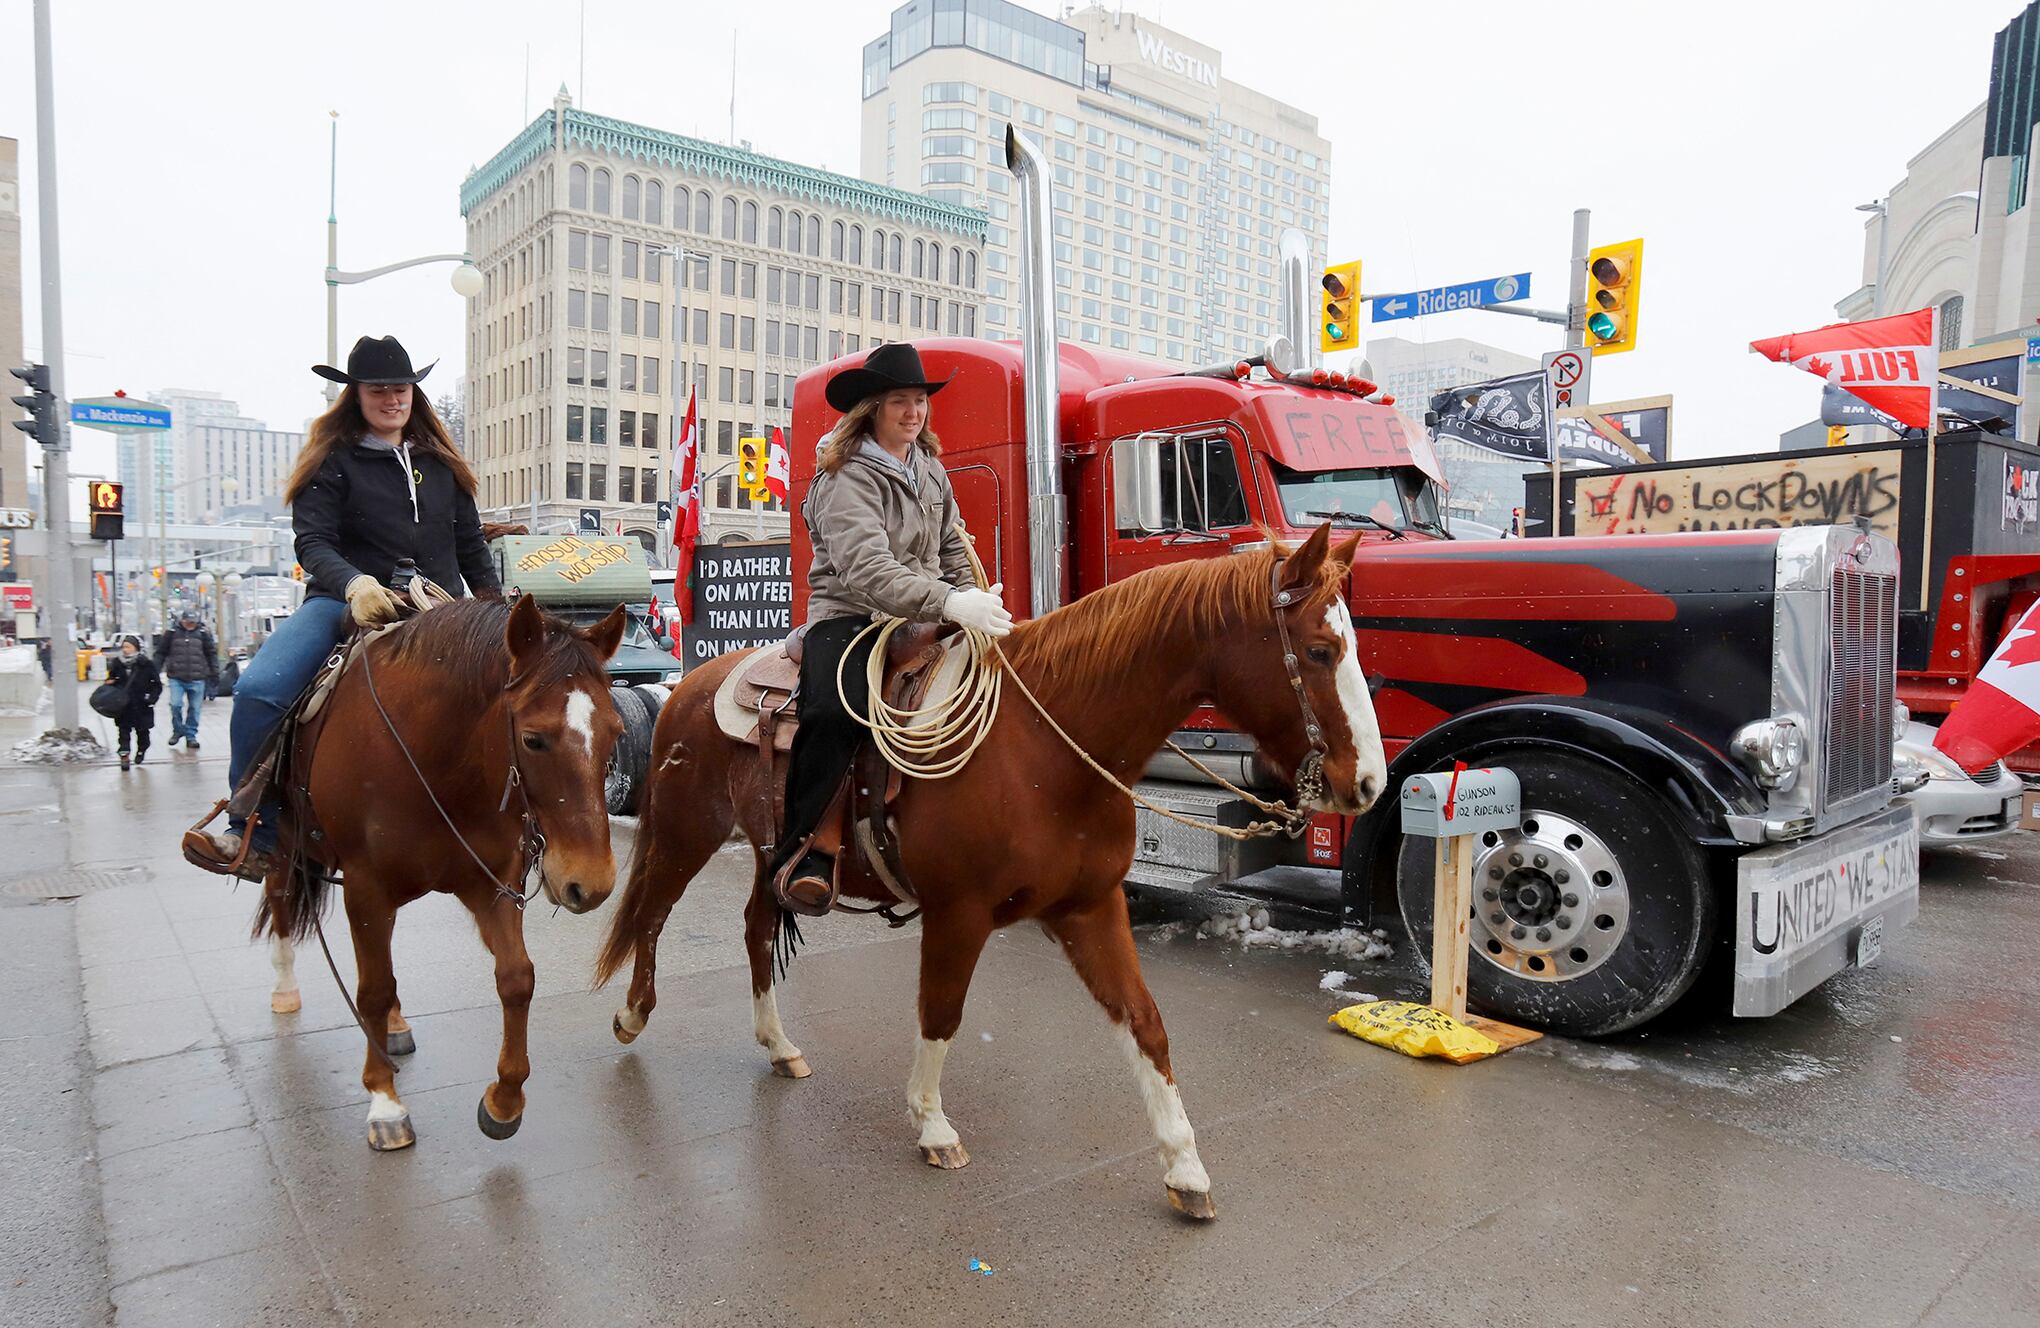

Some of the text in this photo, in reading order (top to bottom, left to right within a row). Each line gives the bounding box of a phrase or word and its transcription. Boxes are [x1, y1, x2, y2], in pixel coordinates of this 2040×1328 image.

[1136, 28, 1218, 88] WESTIN
[1417, 287, 1481, 314] Rideau
[90, 408, 147, 424] Mackenzie
[517, 536, 586, 572] #nosun
[557, 544, 631, 583] worship
[700, 560, 719, 578] I'D
[723, 556, 781, 577] RATHER
[705, 584, 730, 602] ON
[735, 582, 760, 601] MY
[709, 609, 789, 629] THAN LIVE
[696, 640, 719, 657] ON
[1457, 786, 1496, 801] GUNSON
[1474, 805, 1504, 816] RIDEAU
[1752, 869, 1836, 954] UNITED
[1846, 851, 1874, 912] WE
